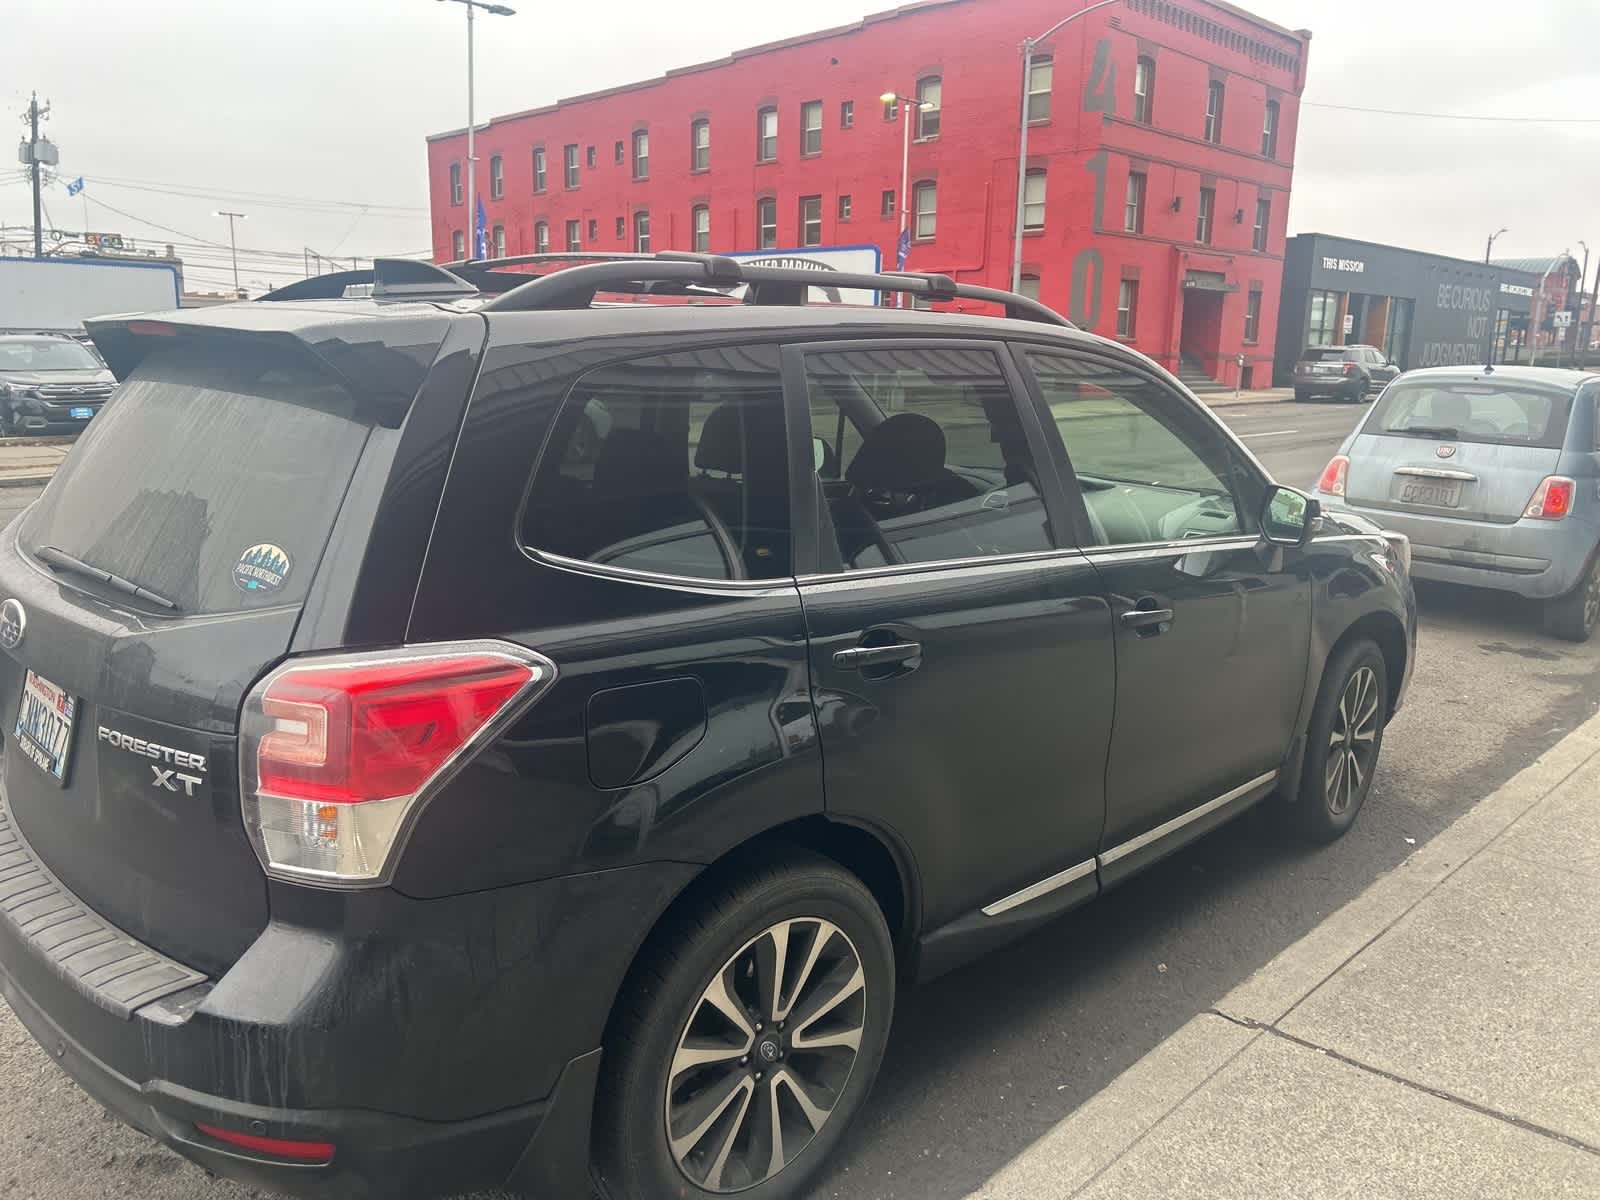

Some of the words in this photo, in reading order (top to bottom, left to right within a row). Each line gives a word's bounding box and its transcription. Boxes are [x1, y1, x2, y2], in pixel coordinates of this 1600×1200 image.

[1322, 256, 1338, 270] THIS
[1338, 259, 1365, 273] MISSION
[1437, 283, 1452, 309] BE
[1451, 286, 1491, 312] CURIOUS
[1466, 315, 1489, 339] NOT
[98, 725, 207, 772] FORESTER
[151, 764, 202, 796] XT
